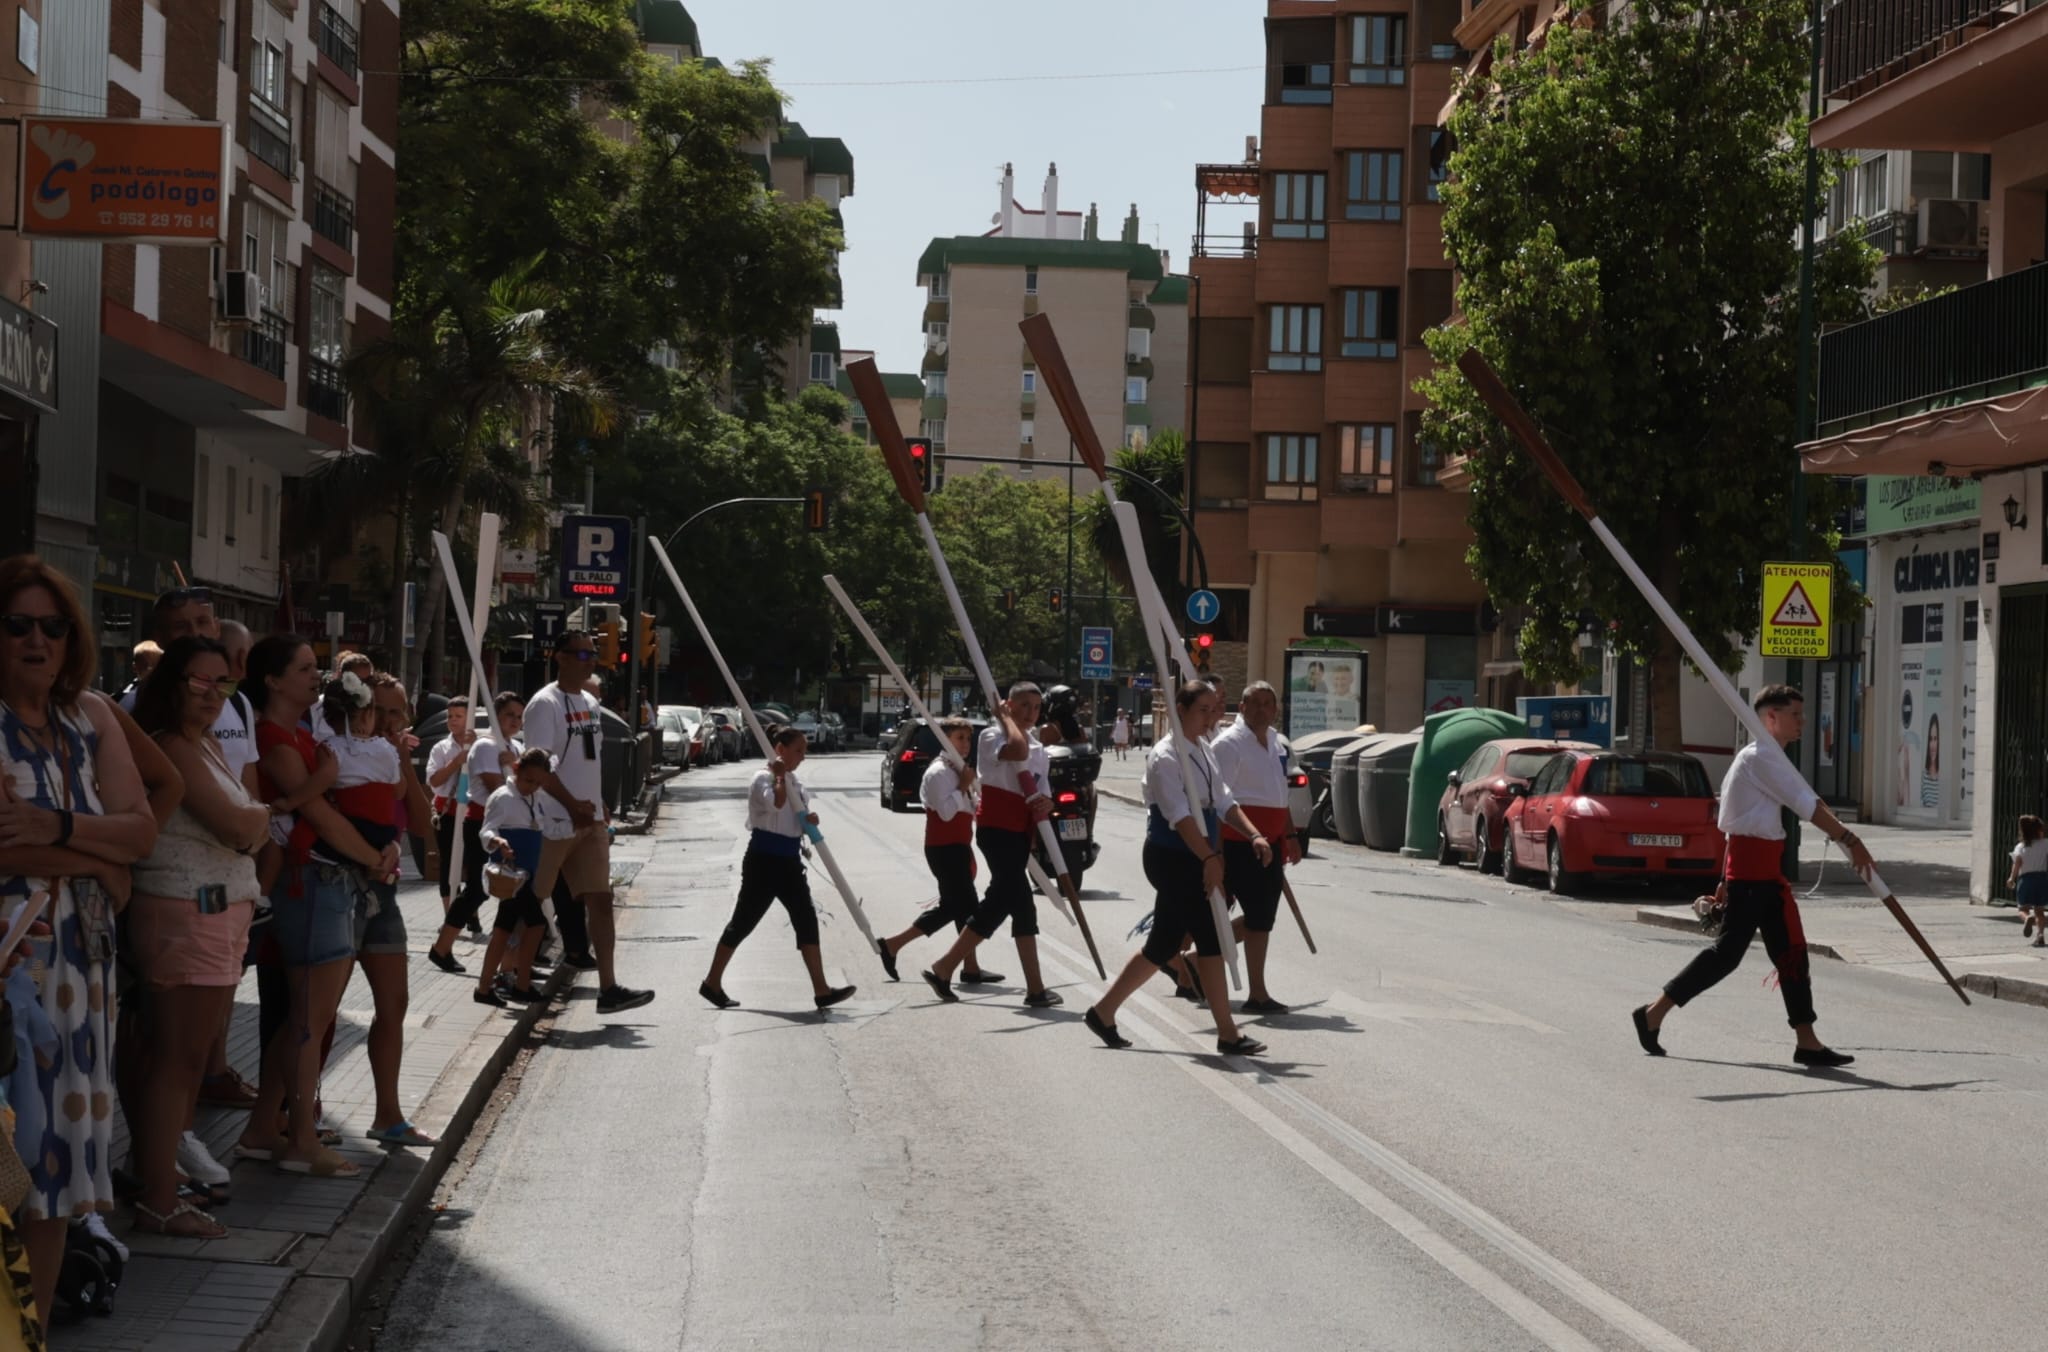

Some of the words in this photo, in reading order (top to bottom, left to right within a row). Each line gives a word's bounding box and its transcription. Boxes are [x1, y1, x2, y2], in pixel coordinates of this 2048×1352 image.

[91, 180, 217, 206] podólogo
[119, 212, 146, 226] 952
[174, 214, 193, 228] 76
[199, 215, 215, 229] 14
[577, 525, 614, 566] P
[1765, 567, 1830, 577] ATENCION
[1894, 544, 1951, 593] CLÍNICA
[575, 572, 586, 581] EL
[589, 573, 613, 582] PALO
[572, 584, 615, 595] COMPLETO
[541, 615, 559, 636] T
[1773, 628, 1817, 637] MODERE
[540, 640, 556, 648] TAX
[1767, 637, 1825, 646] VELOCIDAD
[1772, 646, 1818, 655] COLEGIO
